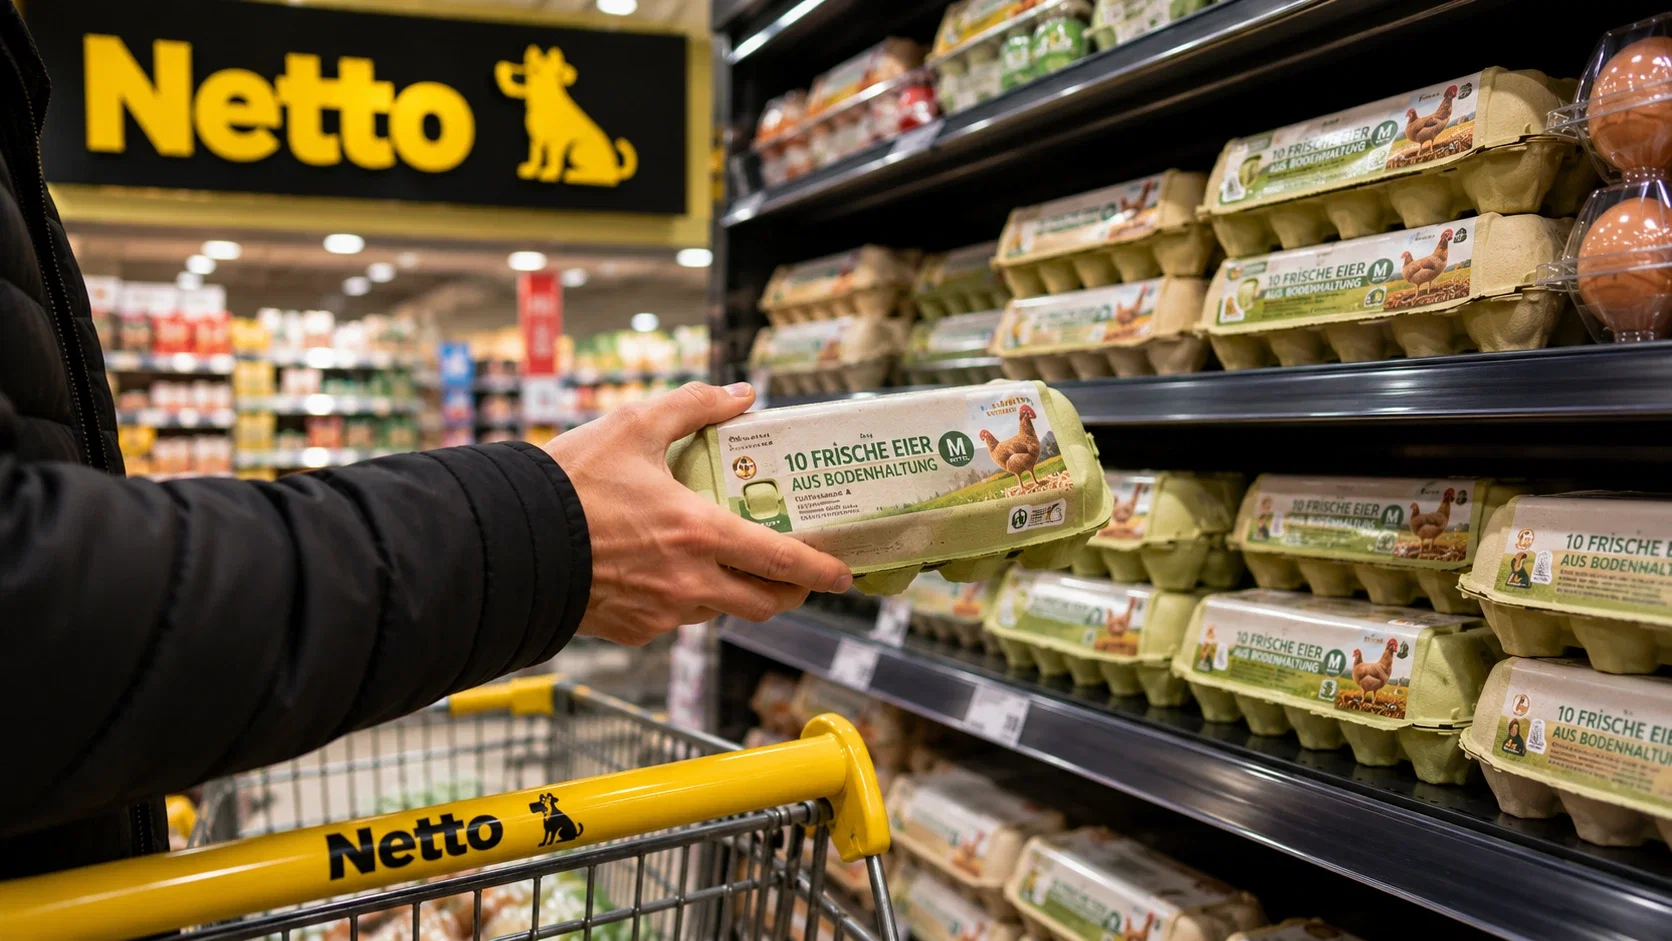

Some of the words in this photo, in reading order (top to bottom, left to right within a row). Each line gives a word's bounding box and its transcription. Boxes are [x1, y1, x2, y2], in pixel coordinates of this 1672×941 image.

[84, 33, 476, 173] Netto
[1377, 123, 1394, 140] M
[1268, 274, 1280, 287] 10
[1282, 266, 1334, 284] FRISCHE
[1336, 262, 1366, 278] EIER
[1374, 261, 1388, 277] M
[784, 453, 808, 472] 10
[811, 441, 890, 469] FRISCHE
[891, 435, 934, 458] EIER
[946, 437, 967, 457] M
[792, 475, 822, 492] AUS
[825, 457, 938, 487] BODENHALTUNG
[1305, 499, 1351, 514] FRISCHE
[1353, 503, 1380, 516] EIER
[1385, 508, 1400, 524] M
[1566, 533, 1584, 550] 10
[1587, 533, 1662, 557] FRISCHE
[1560, 554, 1588, 568] AUS
[1236, 631, 1248, 644] 10
[1250, 632, 1295, 654] FRISCHE
[1297, 642, 1323, 659] EIER
[1327, 653, 1341, 670] M
[1558, 705, 1575, 723] 10
[1577, 709, 1647, 740] FRISCHE
[1552, 726, 1577, 742] AUS
[325, 813, 503, 881] Netto
